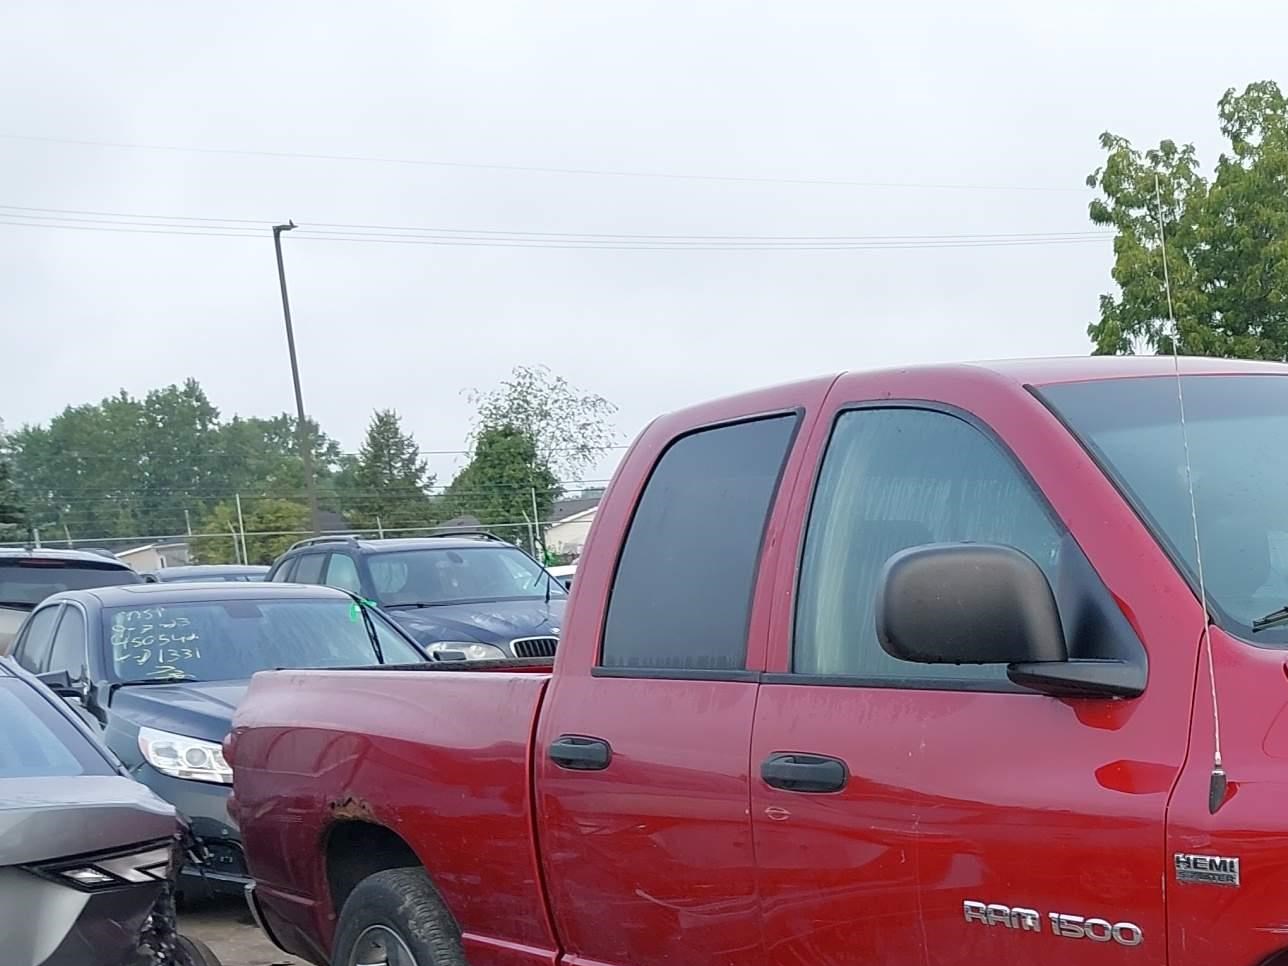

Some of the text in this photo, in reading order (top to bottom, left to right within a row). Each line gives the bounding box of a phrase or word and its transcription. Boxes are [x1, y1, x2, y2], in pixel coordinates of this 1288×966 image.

[1175, 854, 1237, 874] HEMI
[963, 900, 1145, 947] RAM 1500
